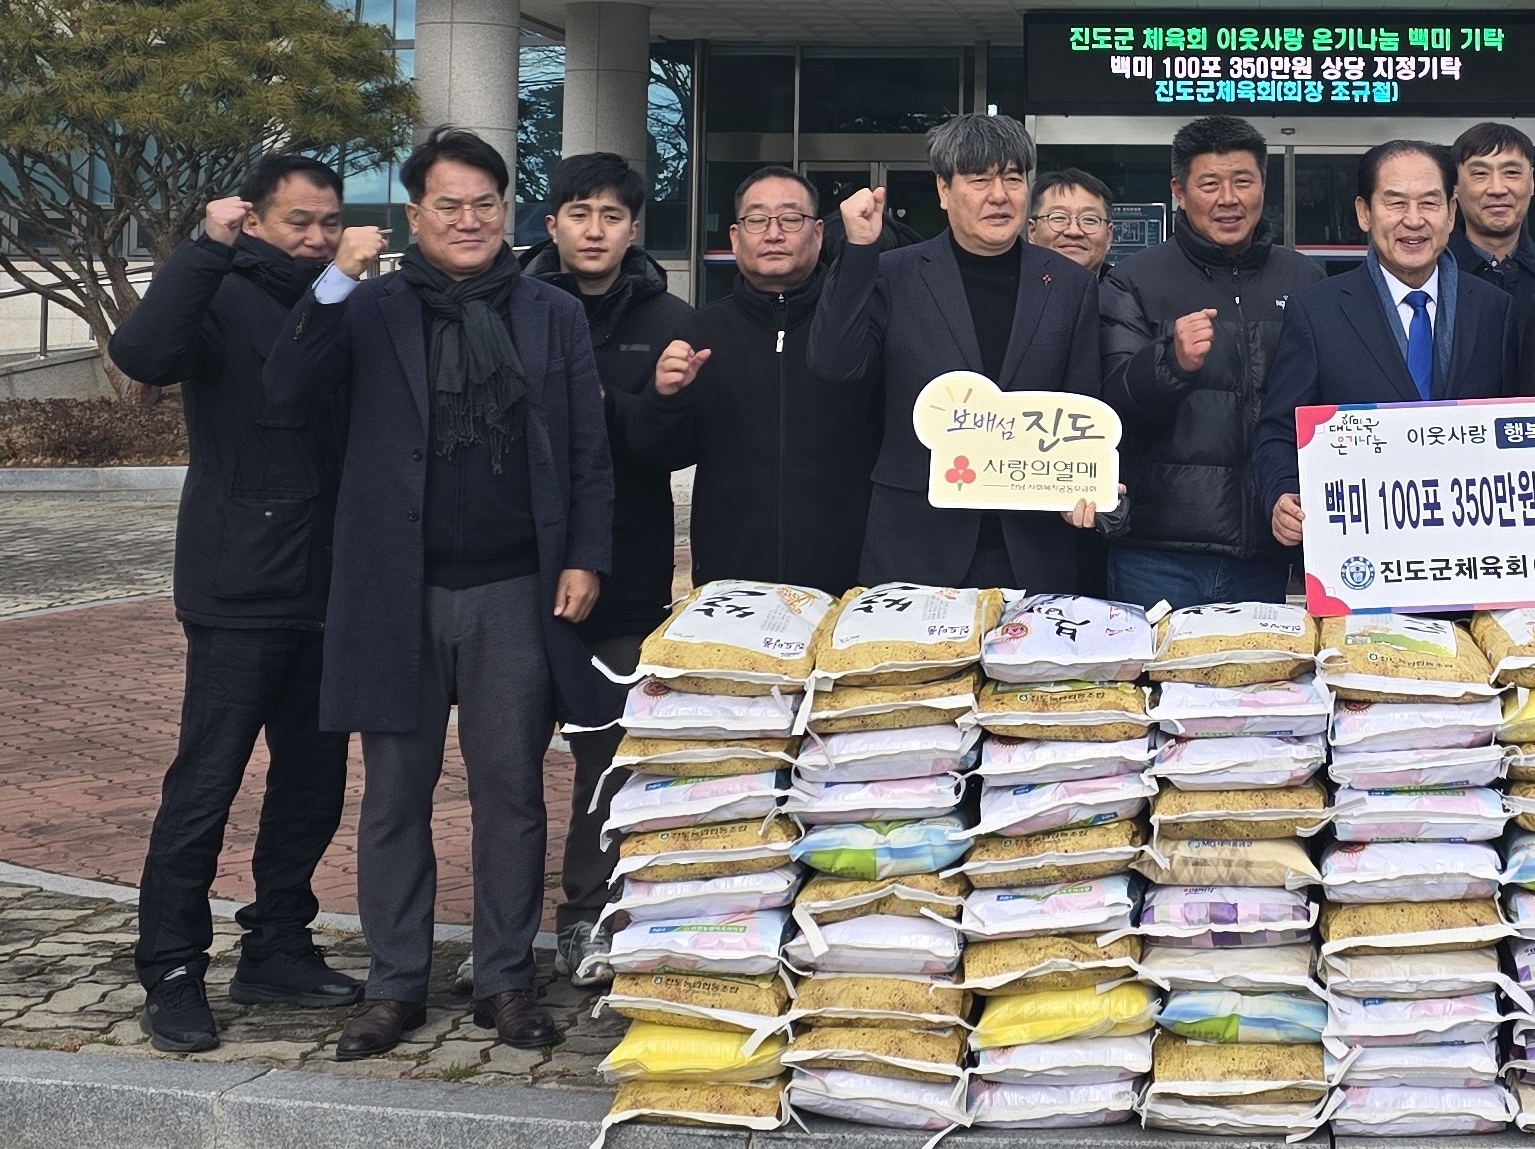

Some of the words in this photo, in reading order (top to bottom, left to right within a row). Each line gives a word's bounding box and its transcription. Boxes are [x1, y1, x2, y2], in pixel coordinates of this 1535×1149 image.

[1069, 27, 1135, 51] 진도군
[1143, 27, 1207, 51] 체육회
[1218, 27, 1304, 51] 이웃사랑
[1313, 27, 1400, 51] 온기나눔
[1409, 27, 1451, 51] 백미
[1461, 27, 1504, 51] 기탁
[1111, 57, 1152, 80] 백미
[1163, 57, 1221, 79] 100포
[1230, 57, 1313, 79] 350만원
[1321, 57, 1365, 80] 상당
[1374, 57, 1462, 80] 지정기탁
[1155, 80, 1325, 103] 진도군체육회(회장
[1334, 80, 1398, 103] 조규철)
[947, 409, 1015, 441] 보배섬
[1022, 408, 1105, 452] 진도
[1329, 414, 1379, 433] 대한민국
[1330, 435, 1387, 455] 온기나눔
[1407, 425, 1488, 447] 이웃사랑
[983, 460, 1097, 482] 사랑의열매
[1325, 478, 1370, 535] 백미
[1378, 479, 1444, 530] 100포
